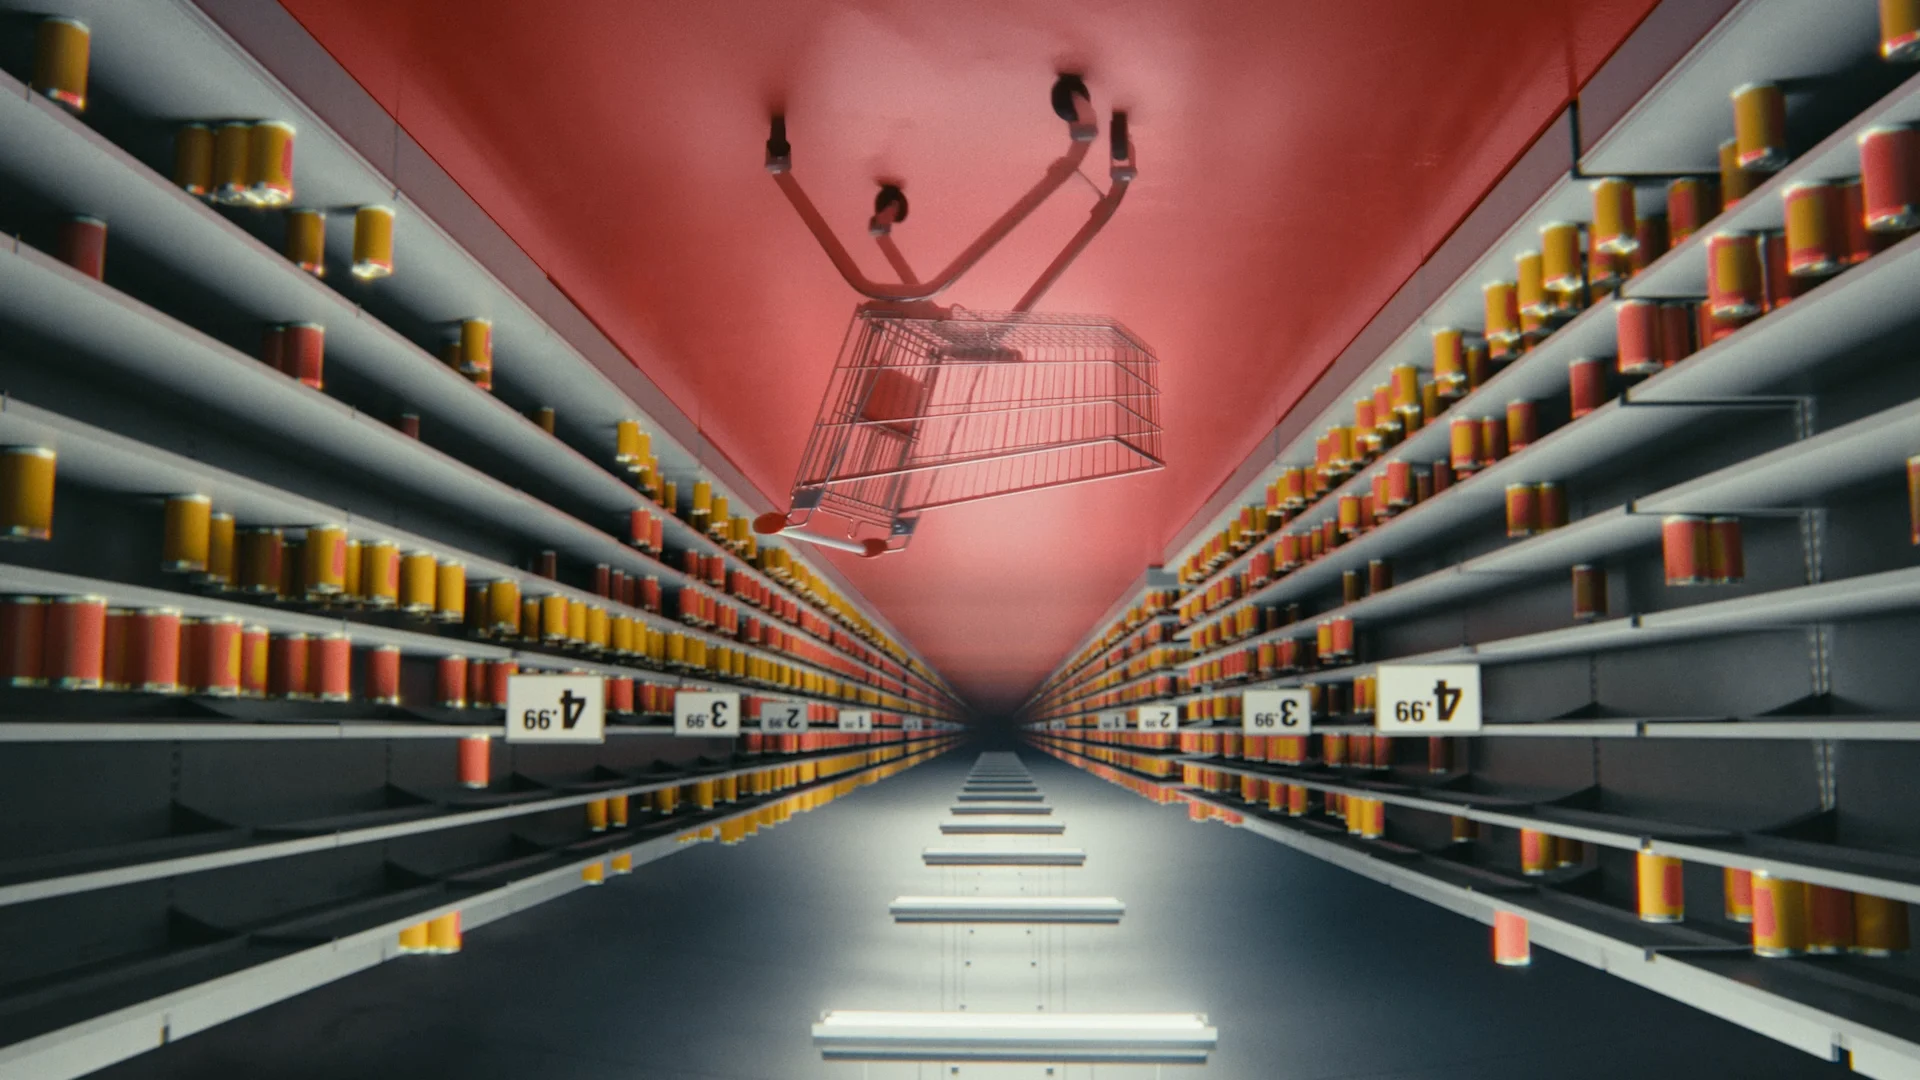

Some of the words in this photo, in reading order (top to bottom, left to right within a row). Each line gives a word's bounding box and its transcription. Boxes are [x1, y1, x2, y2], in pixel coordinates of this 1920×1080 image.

[523, 689, 586, 729] 4.99
[686, 701, 728, 727] 3.99
[1254, 699, 1298, 727] 3.99
[1395, 679, 1463, 722] 4.99
[768, 709, 800, 728] 2.99
